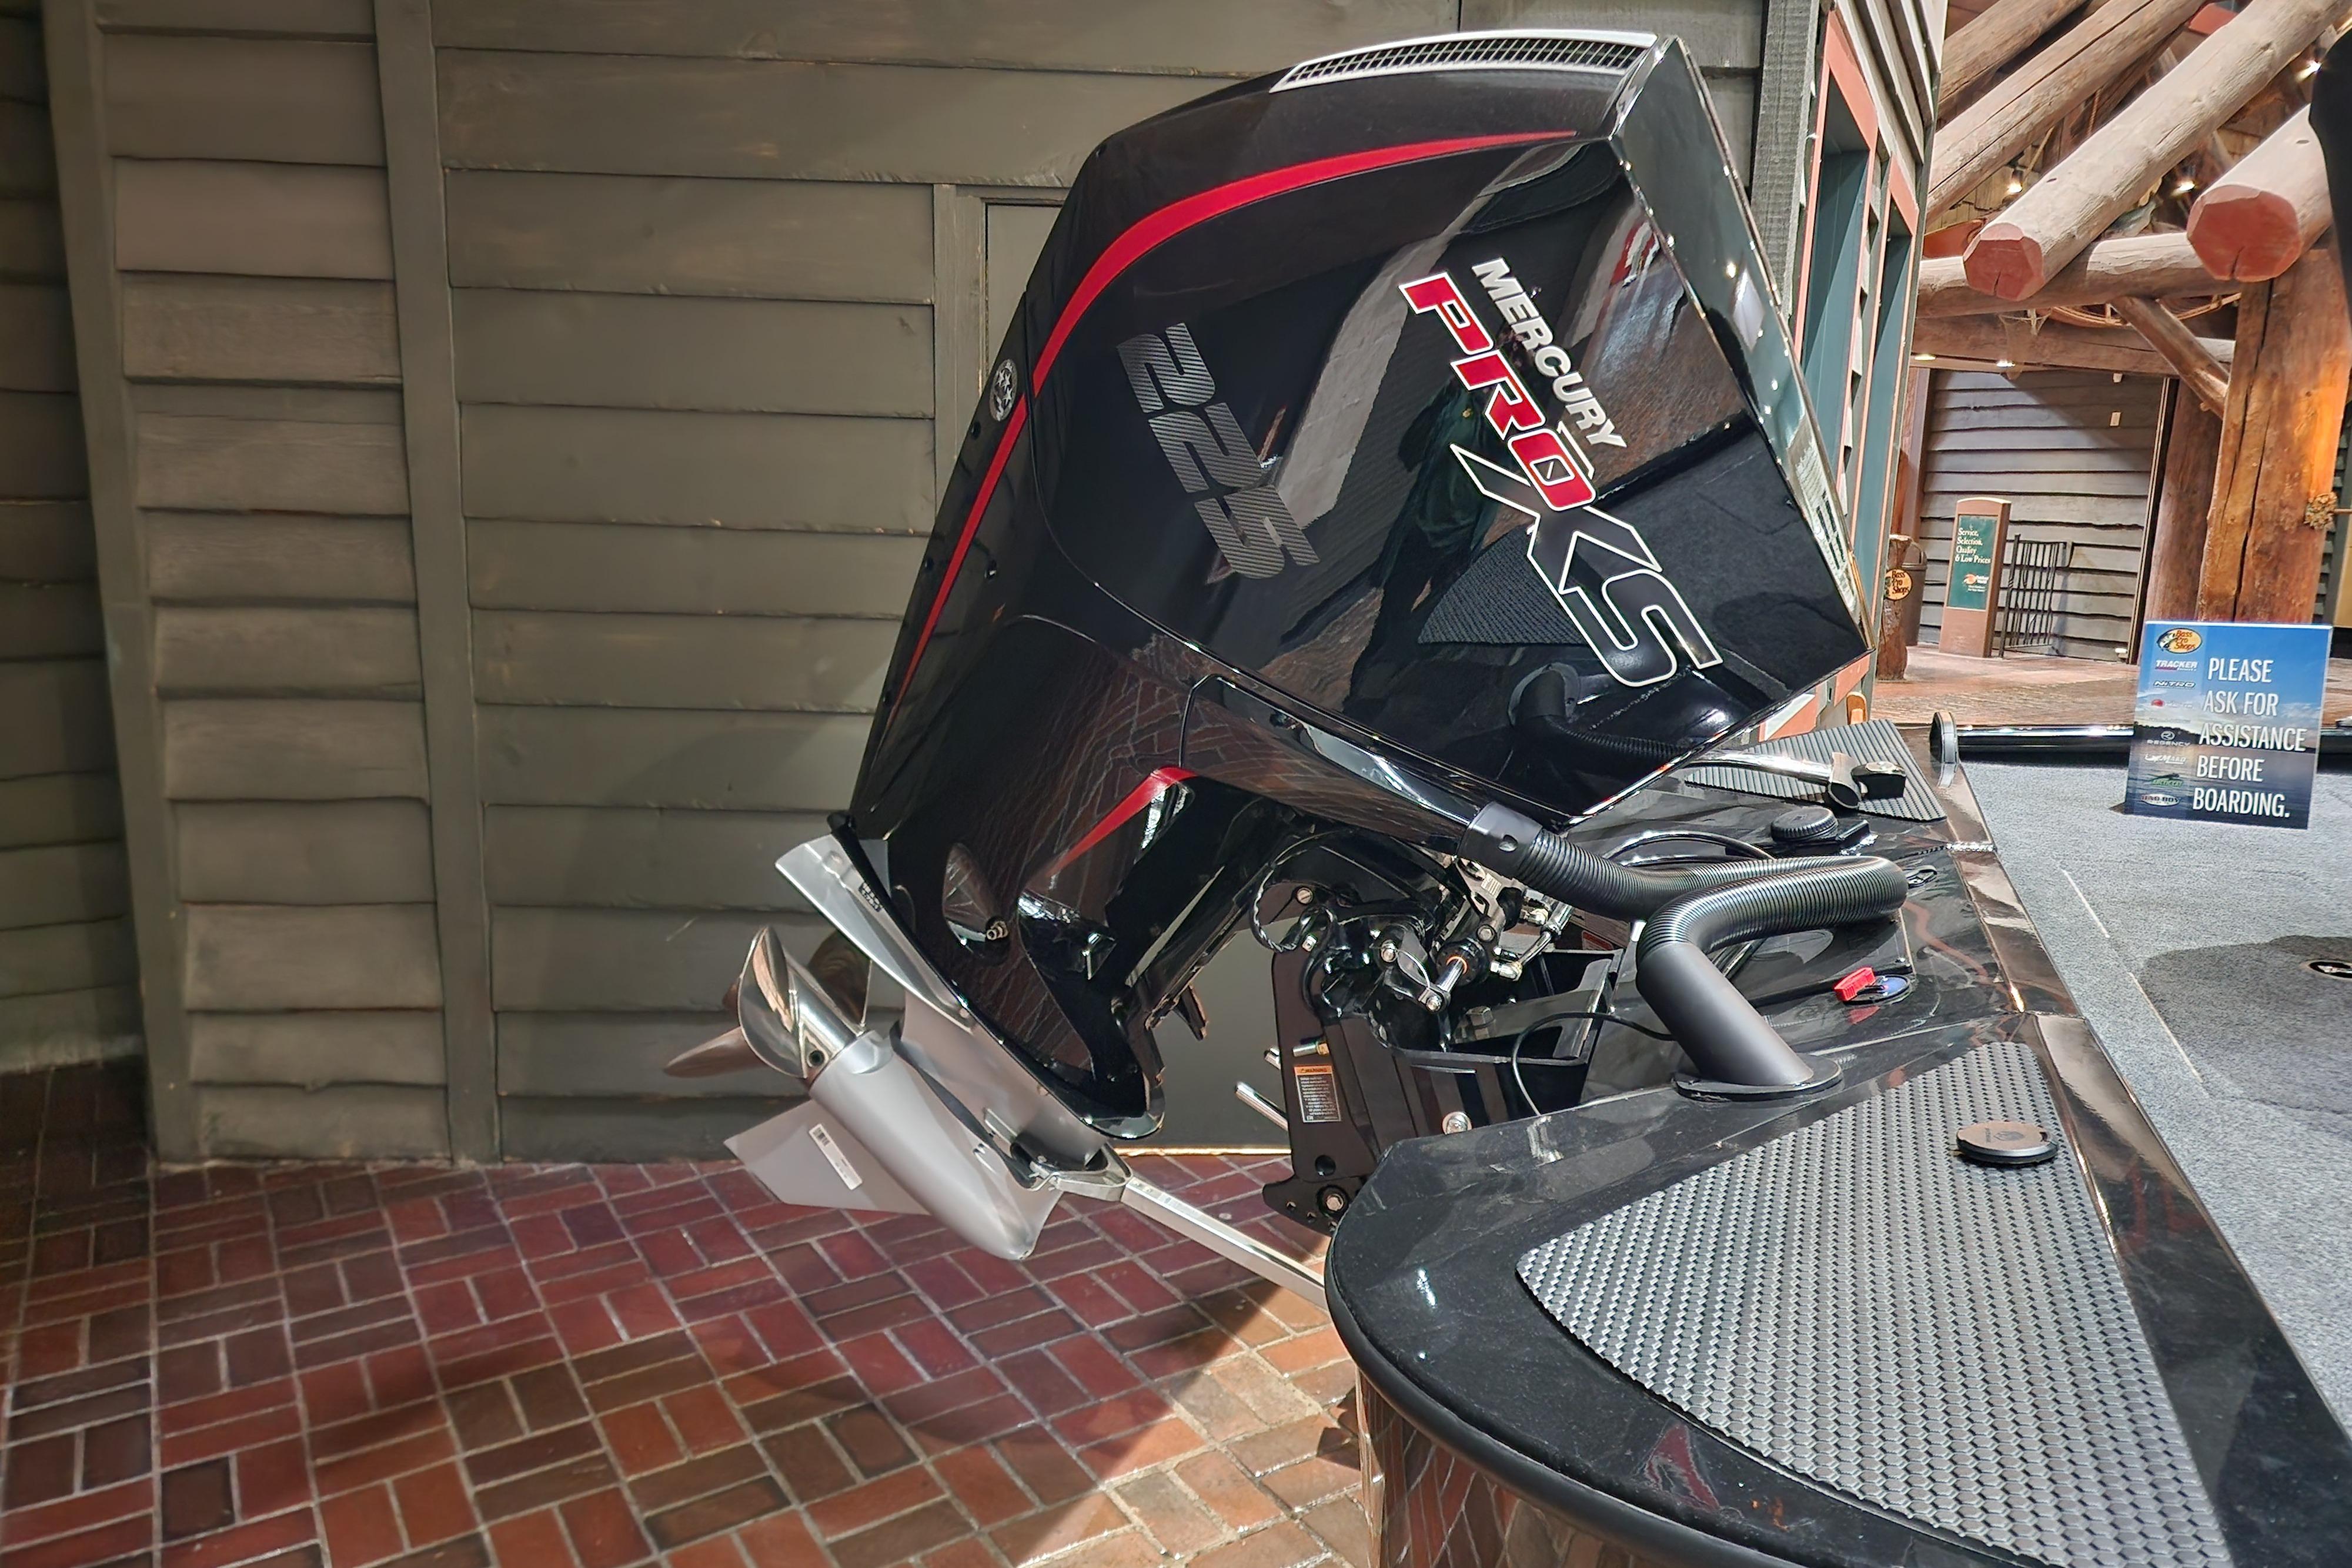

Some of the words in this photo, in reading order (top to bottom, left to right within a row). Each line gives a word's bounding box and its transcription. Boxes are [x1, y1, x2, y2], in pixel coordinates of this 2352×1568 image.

[1472, 258, 1627, 449] MERCURY
[1398, 271, 1596, 511] PRO
[1117, 323, 1321, 579] 225
[1450, 420, 1723, 687] XS
[1956, 545, 1977, 554] Quality
[1974, 555, 1991, 564] Prices
[2174, 643, 2196, 651] Shops
[2156, 660, 2198, 668] TRACKER
[2207, 657, 2274, 683] PLEASE
[2203, 690, 2239, 714] ASK
[2243, 692, 2279, 717] FOR
[2199, 722, 2307, 752] ASSISTANCE
[2196, 754, 2265, 783] BEFORE
[2192, 787, 2290, 818] BOARDING.
